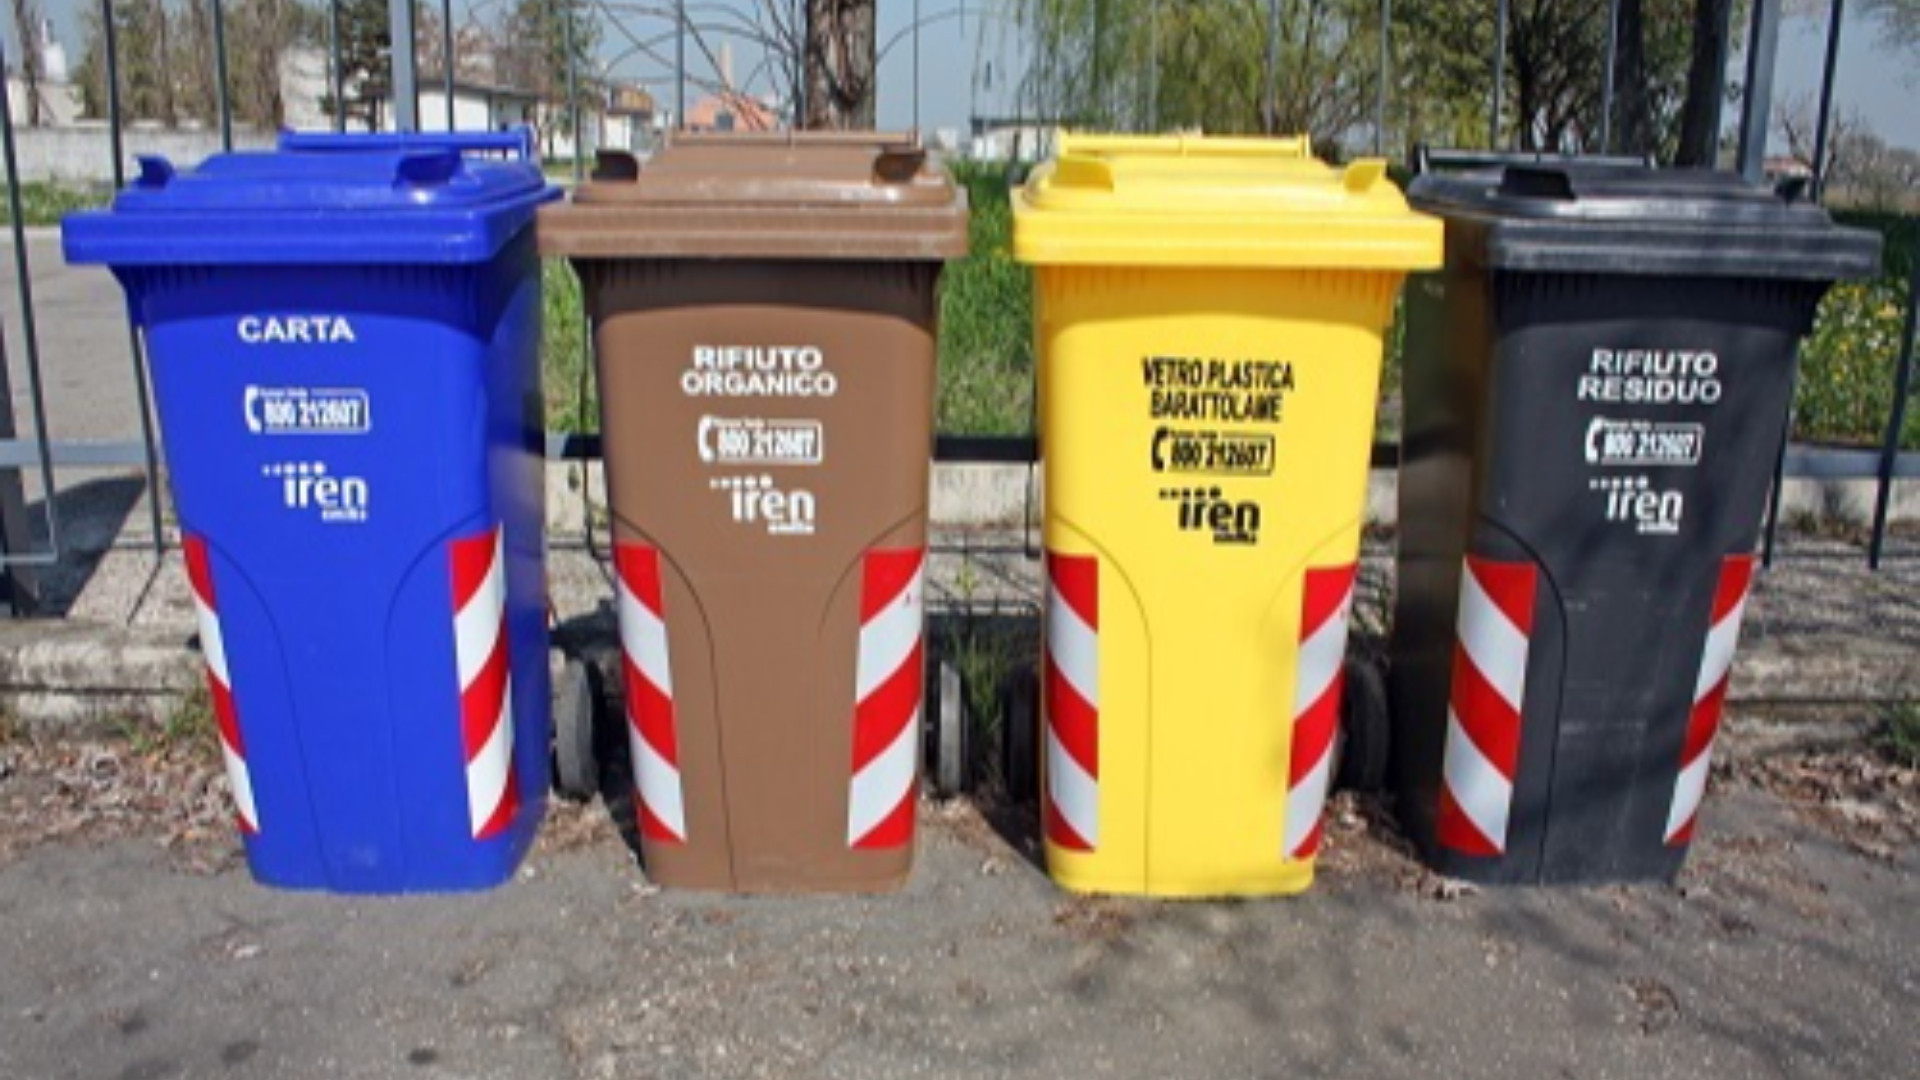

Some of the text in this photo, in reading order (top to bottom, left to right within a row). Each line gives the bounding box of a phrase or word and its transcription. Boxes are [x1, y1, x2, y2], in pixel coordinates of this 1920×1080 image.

[237, 315, 356, 342] CARTA
[694, 345, 823, 370] RIFIUTO
[1142, 356, 1294, 391] VETRO PLASTICA
[1591, 347, 1718, 376] RIFIUTO
[680, 370, 838, 396] ORGANICO
[1577, 375, 1722, 404] RESIDUO
[1150, 389, 1283, 423] BARATTOLAME
[283, 463, 368, 508] iren
[732, 474, 816, 522] iren
[1606, 475, 1683, 520] iren
[1178, 487, 1260, 531] iren
